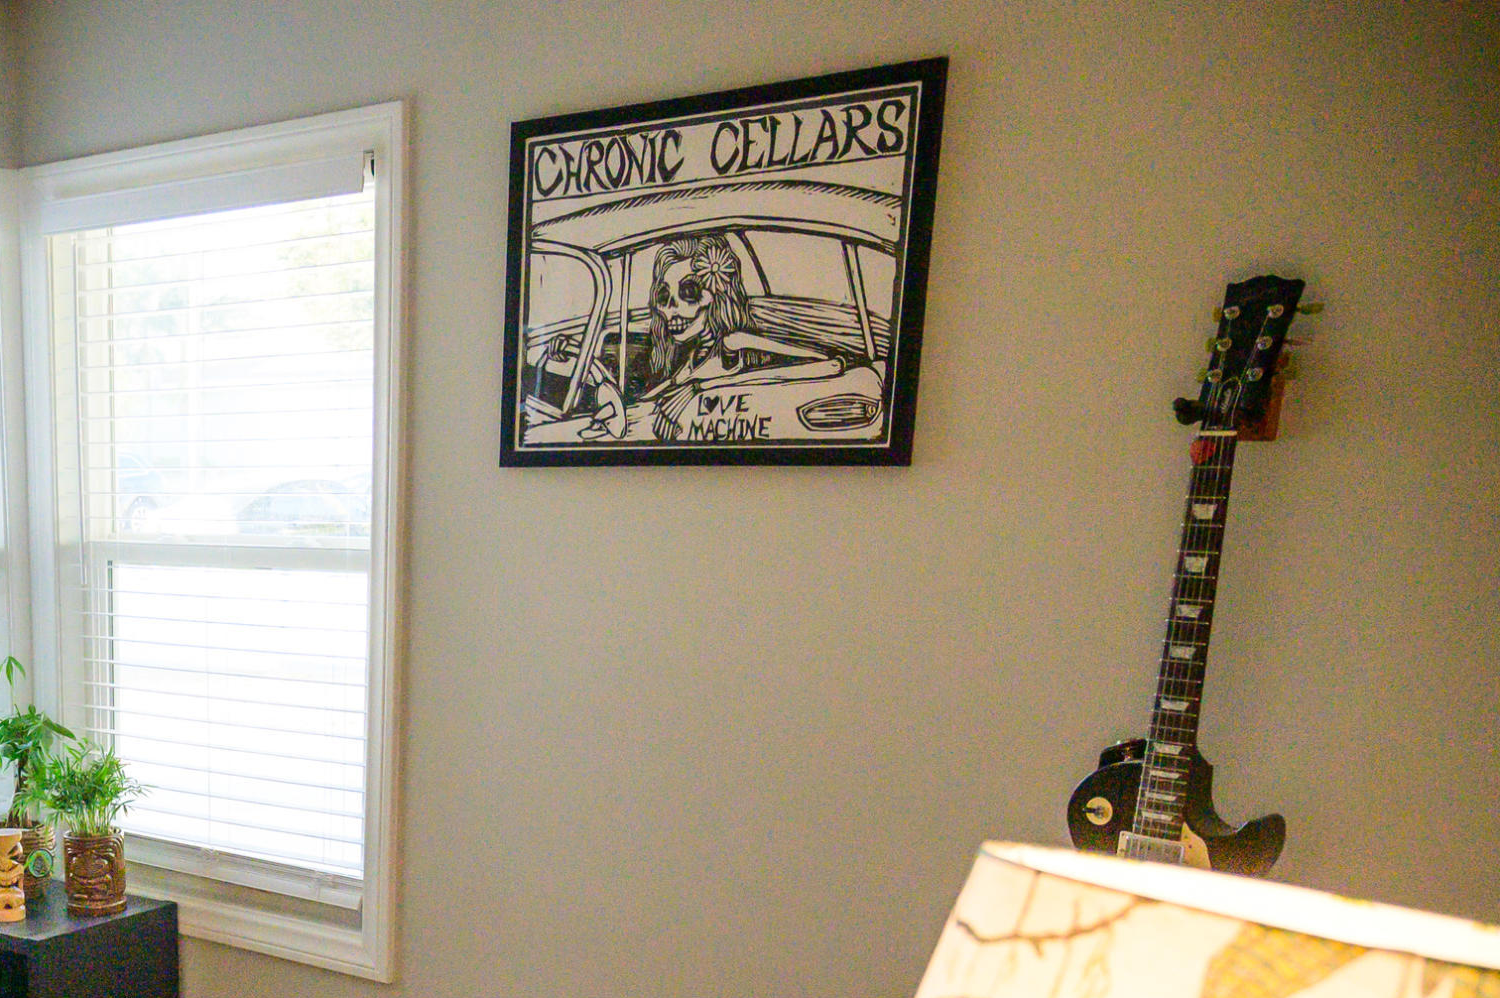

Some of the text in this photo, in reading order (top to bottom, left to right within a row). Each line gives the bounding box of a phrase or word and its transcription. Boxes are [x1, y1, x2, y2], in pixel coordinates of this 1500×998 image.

[534, 100, 906, 197] CHRONIC CELLARS
[687, 416, 772, 441] MACHINE
